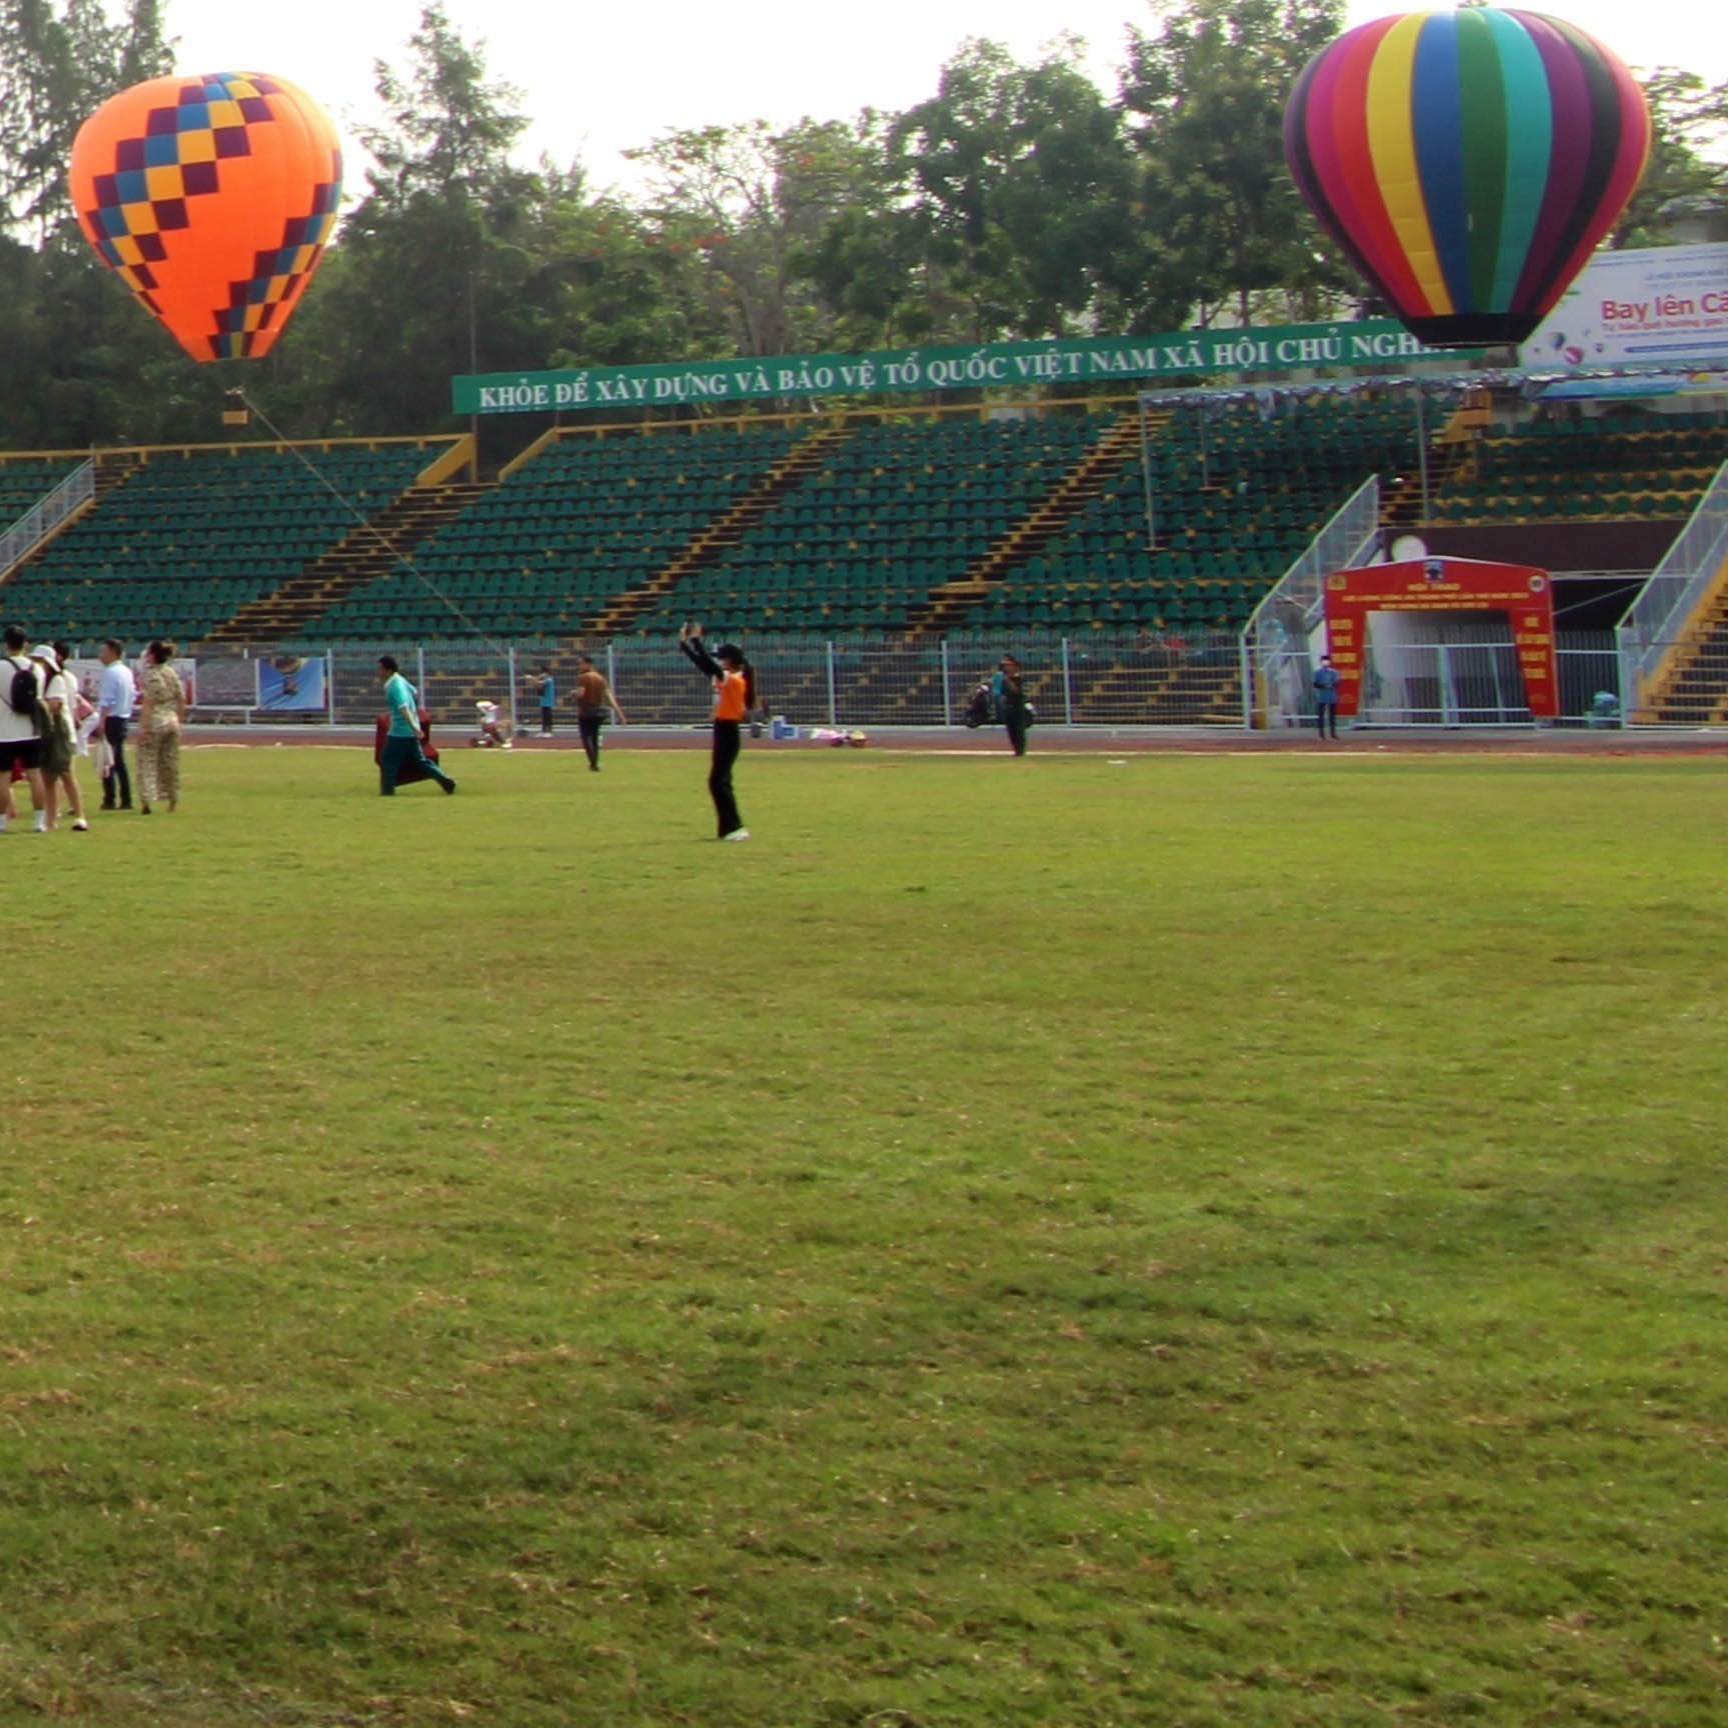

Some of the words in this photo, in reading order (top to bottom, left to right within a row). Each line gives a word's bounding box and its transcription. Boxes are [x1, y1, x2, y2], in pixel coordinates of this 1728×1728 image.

[1601, 300, 1649, 323] Bay
[1655, 294, 1694, 316] lên
[479, 378, 548, 408] KHỎE
[555, 371, 588, 403] ĐỂ
[596, 374, 648, 401] XÂY
[654, 371, 728, 401] DỰNG
[735, 365, 771, 393] VÀ
[777, 360, 833, 391] BẢO
[840, 359, 876, 390] VỆ
[882, 351, 921, 385] TỔ
[926, 348, 1007, 386] QUỐC
[1014, 347, 1084, 380] VIỆT
[1089, 348, 1157, 372] NAM
[1163, 340, 1205, 369] XÃ
[1213, 336, 1271, 369] HỘI
[1276, 327, 1342, 363] CHỦ
[1351, 332, 1456, 359] NGH
